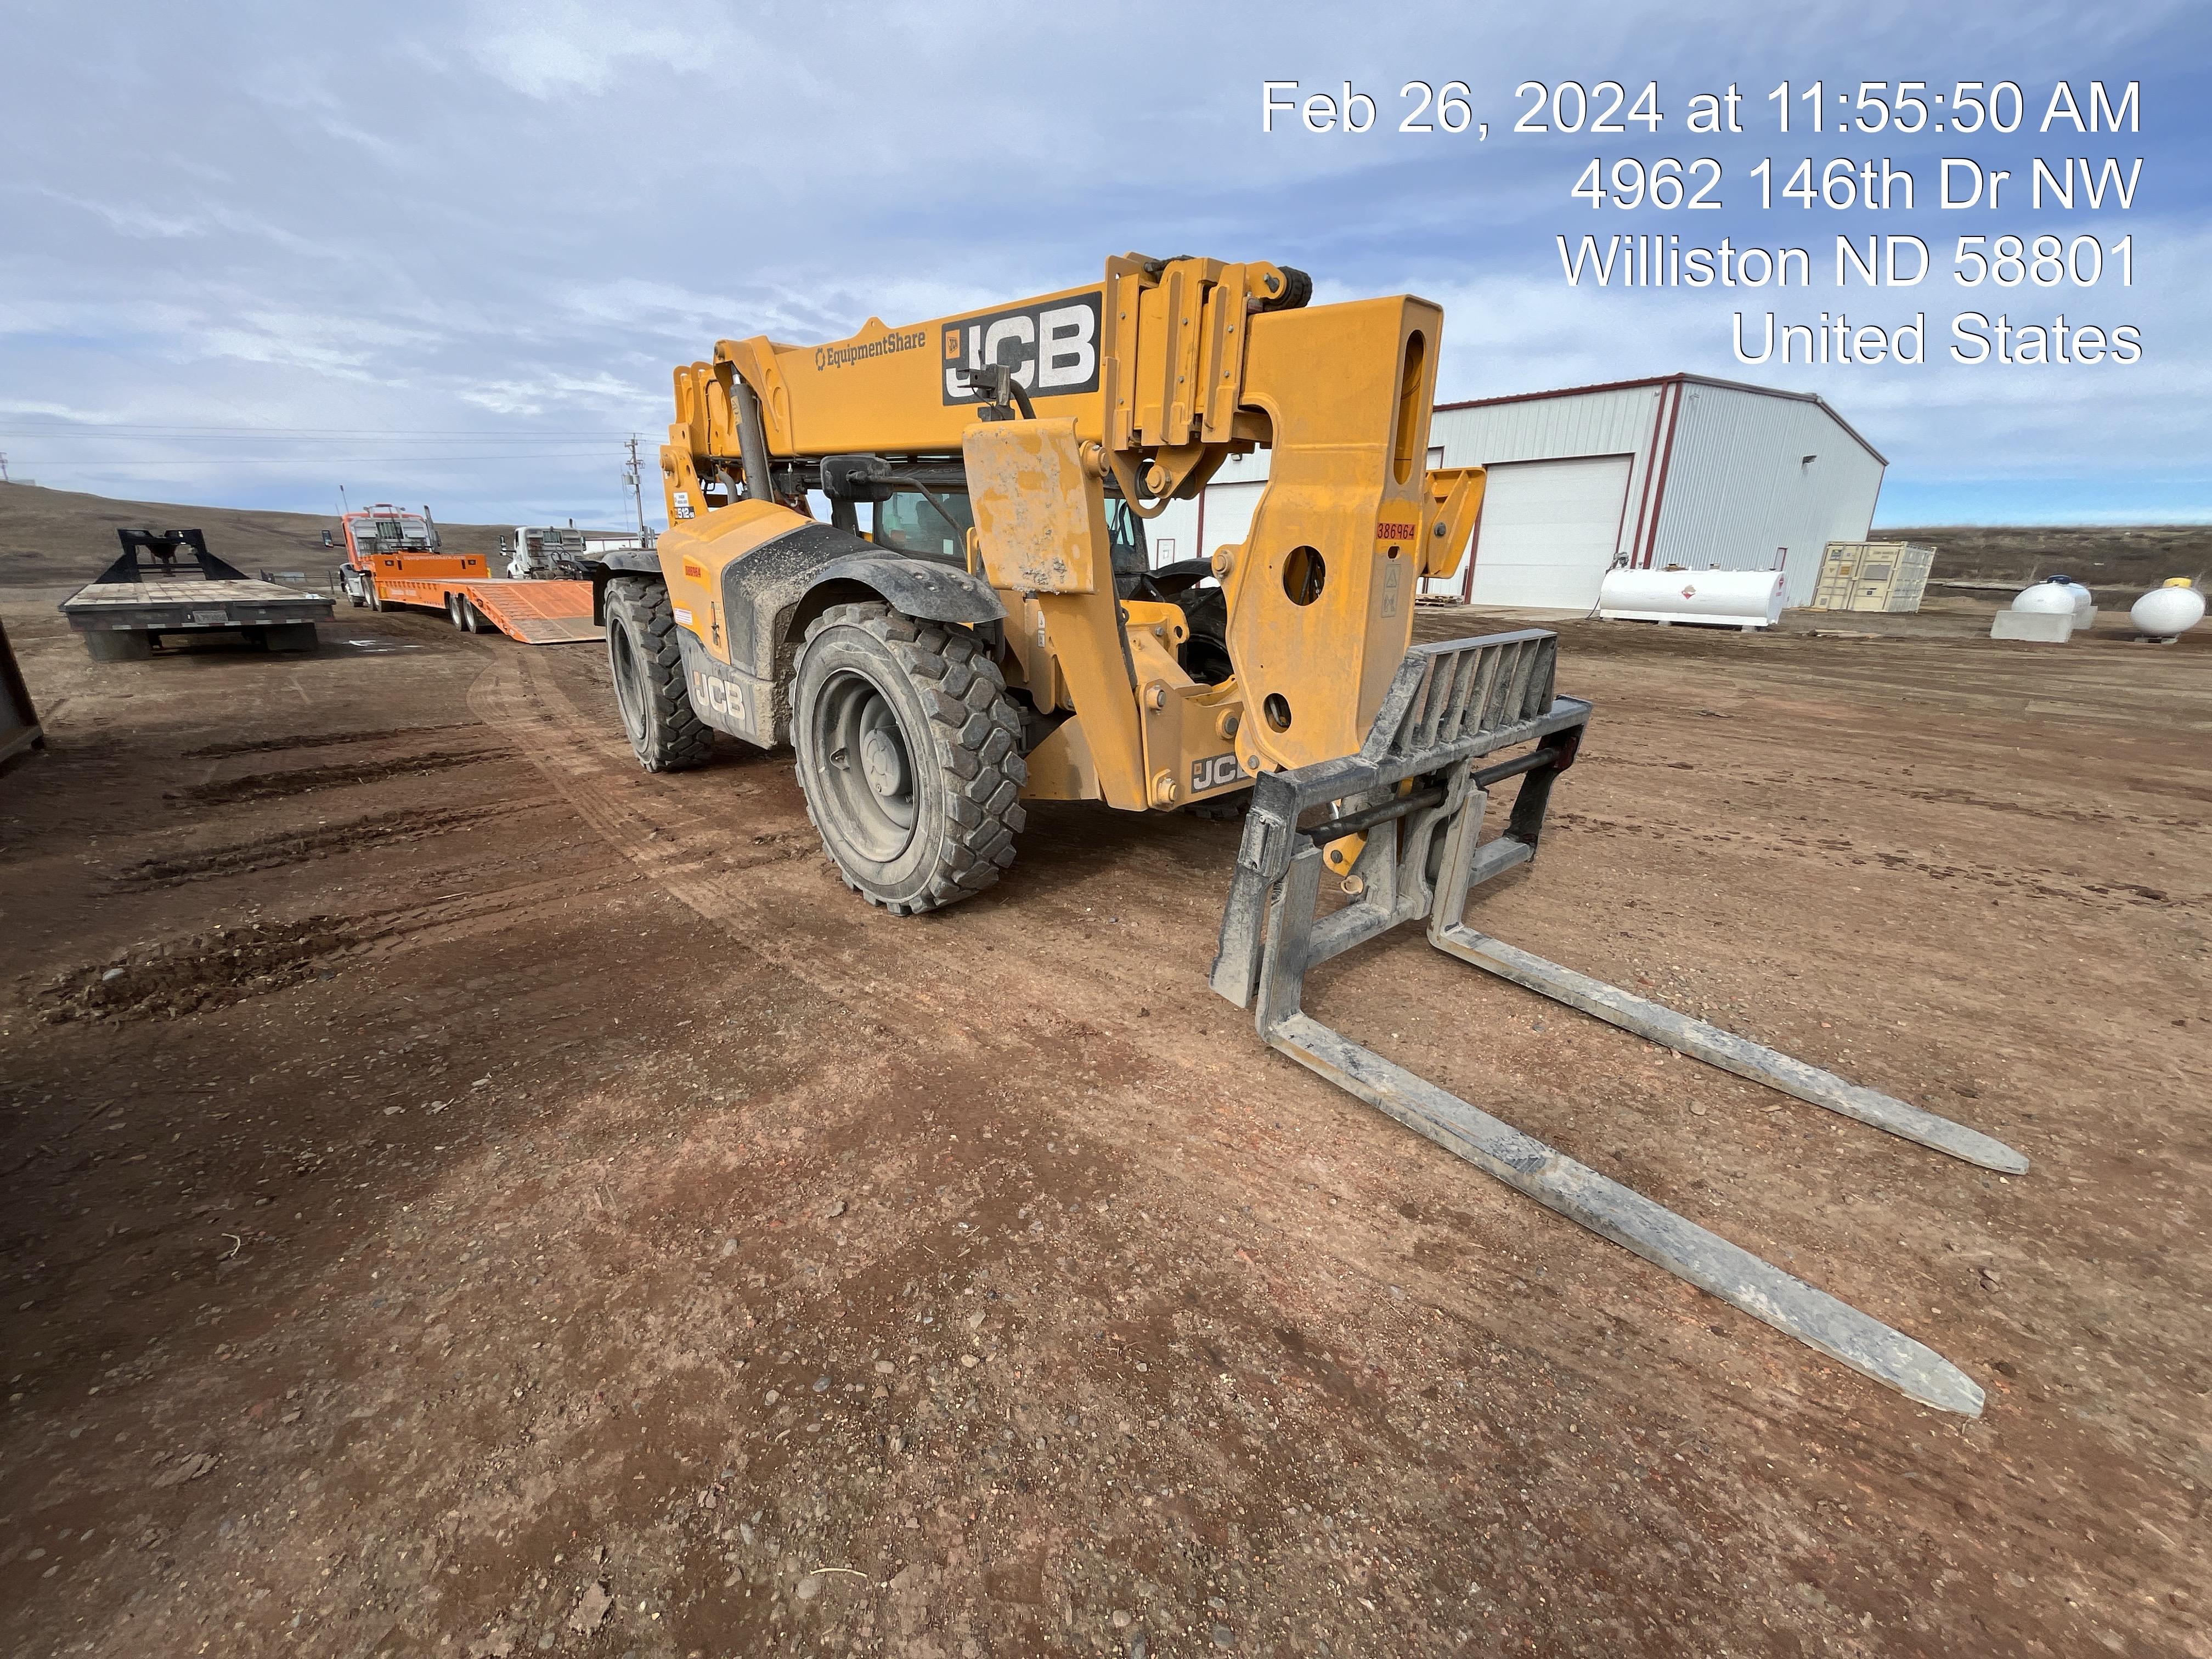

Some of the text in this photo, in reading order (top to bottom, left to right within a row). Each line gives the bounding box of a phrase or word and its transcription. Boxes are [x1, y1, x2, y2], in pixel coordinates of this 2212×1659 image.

[827, 331, 926, 368] EquipmentShare
[946, 304, 1095, 398] JCB
[1378, 523, 1415, 540] 386964
[695, 673, 746, 720] JCB
[1193, 755, 1250, 789] JC
